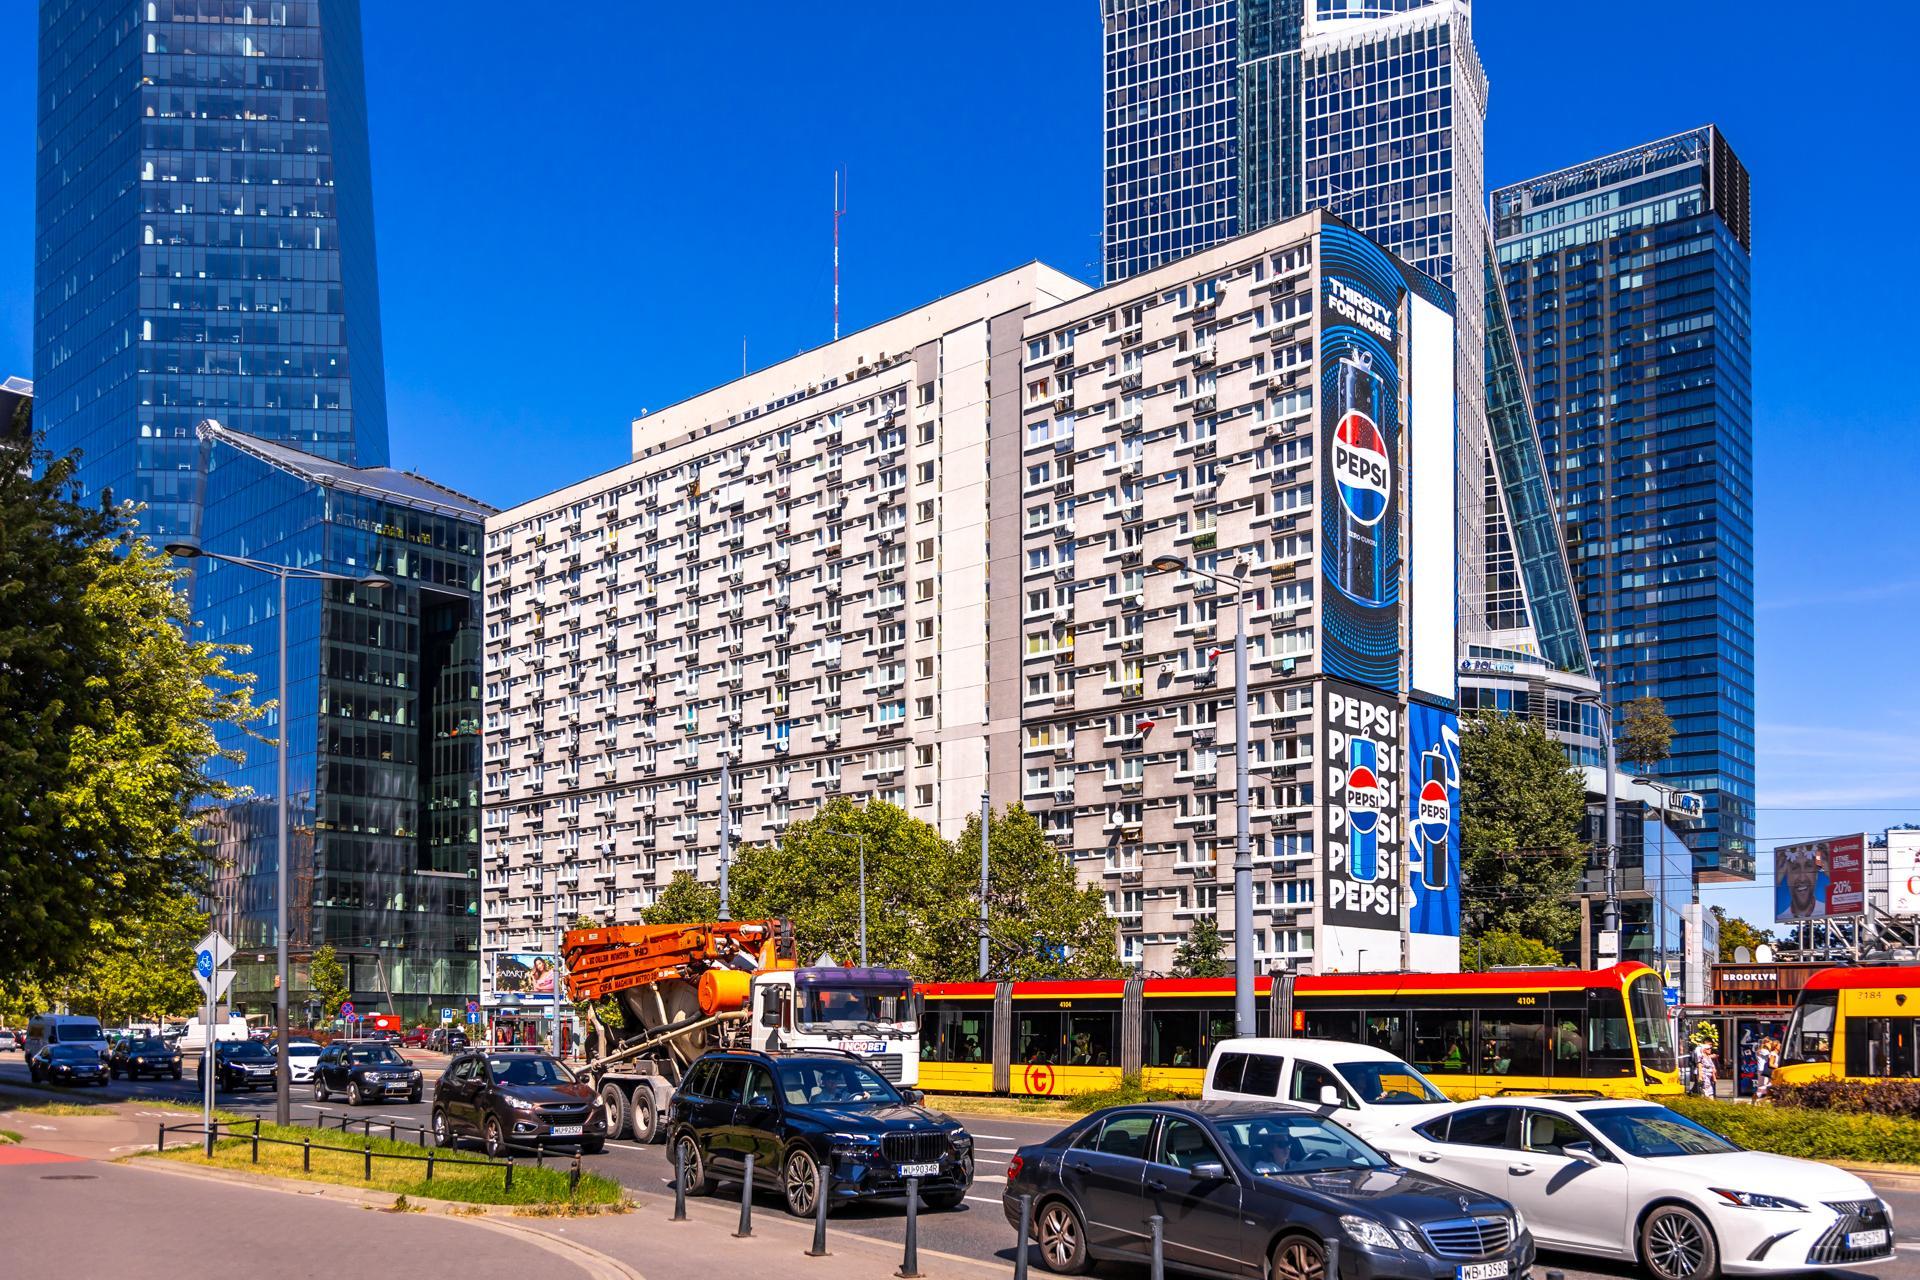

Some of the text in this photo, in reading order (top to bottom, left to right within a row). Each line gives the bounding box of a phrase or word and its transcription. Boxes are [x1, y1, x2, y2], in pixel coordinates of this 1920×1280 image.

[1329, 277, 1393, 323] THIRSTY
[1329, 297, 1392, 341] FOR MORE
[1336, 446, 1387, 490] PEPSI
[1328, 692, 1397, 738] PEPSI
[1328, 729, 1397, 774] PSI
[1328, 766, 1397, 809] PSI
[1348, 790, 1379, 808] PEPSI
[1328, 803, 1397, 845] PSI
[1420, 803, 1448, 821] PEPSI
[1328, 840, 1397, 881] PSI
[1328, 878, 1397, 917] PEPSI
[1833, 880, 1852, 894] 20%
[500, 970, 525, 978] APART
[1723, 973, 1777, 981] BROOKLYN
[1517, 997, 1535, 1005] 4104
[915, 1164, 938, 1174] 9034R
